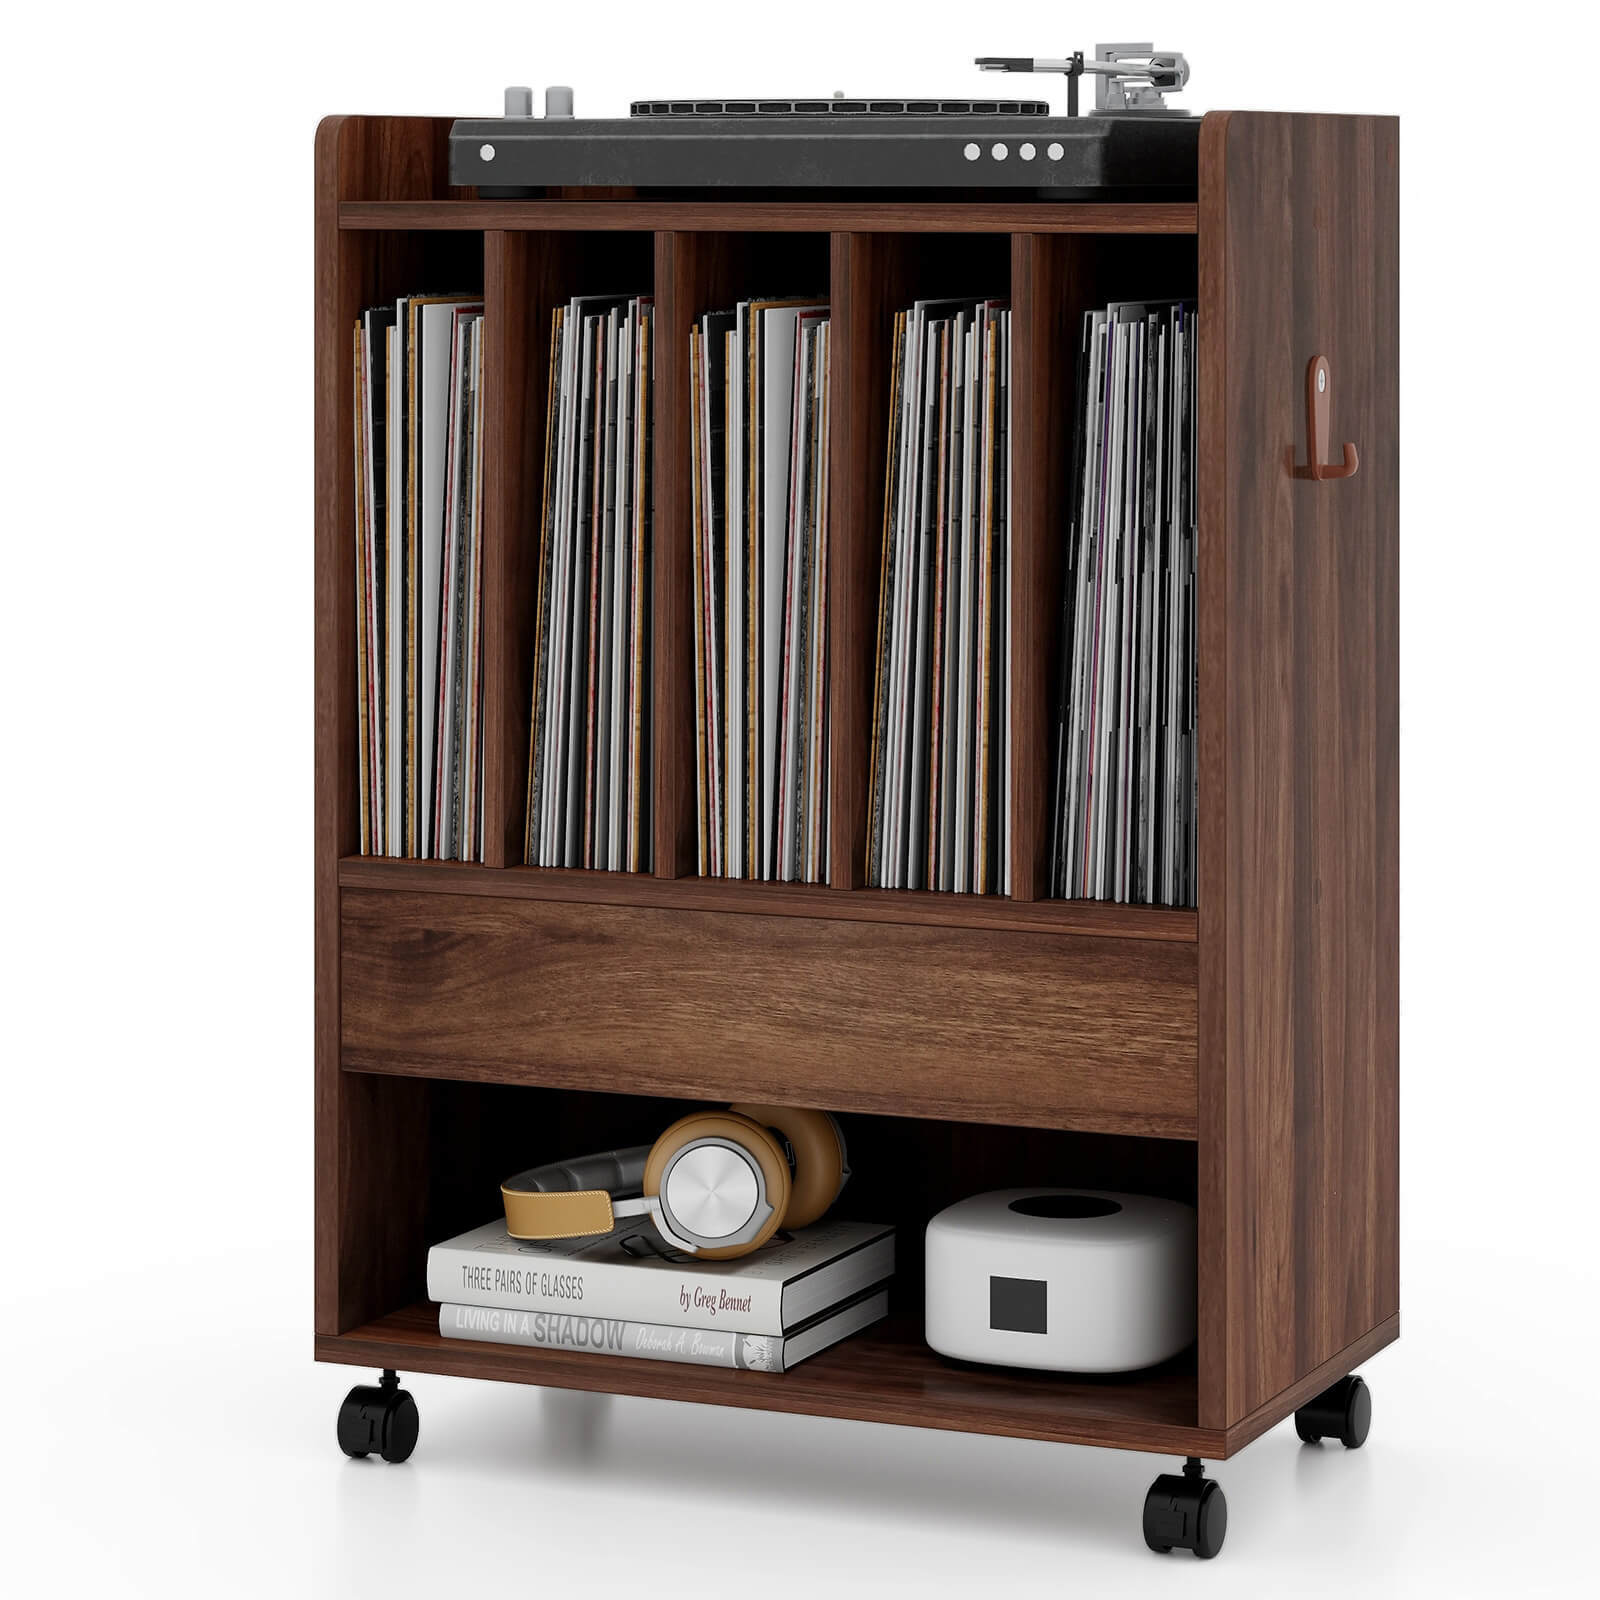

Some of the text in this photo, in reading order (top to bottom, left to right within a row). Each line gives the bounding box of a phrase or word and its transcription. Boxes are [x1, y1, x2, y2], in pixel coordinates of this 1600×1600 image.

[462, 1265, 584, 1300] THREE PAIRS OF GLASSES
[680, 1284, 752, 1316] by Greg Bennet
[456, 1308, 627, 1351] LIVING IN A SHADOW
